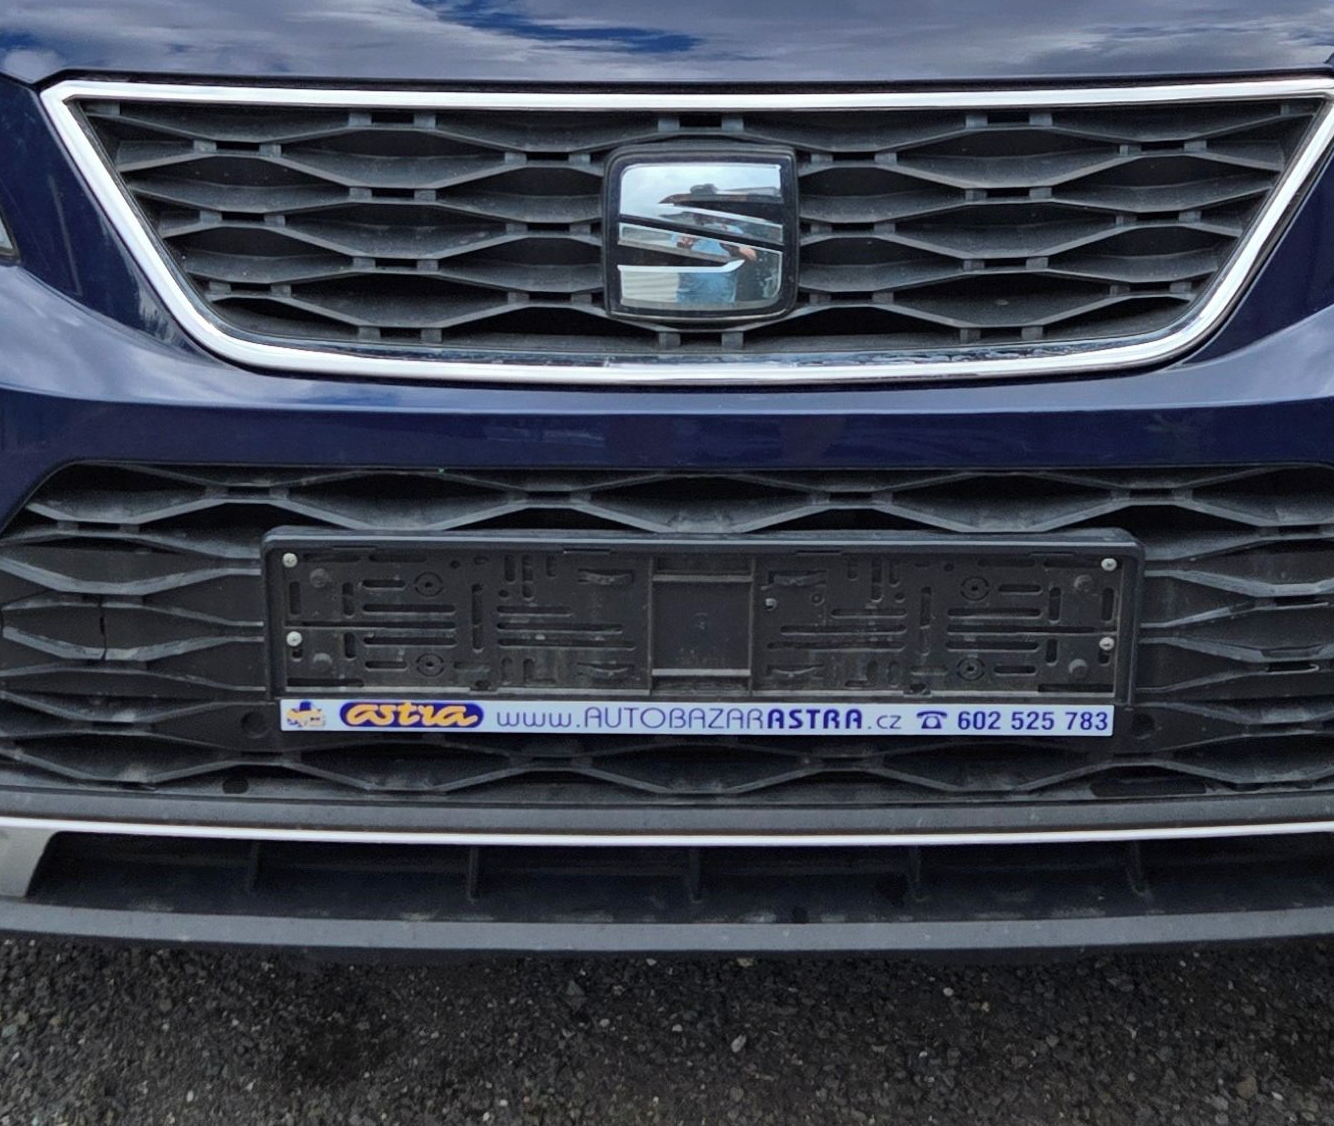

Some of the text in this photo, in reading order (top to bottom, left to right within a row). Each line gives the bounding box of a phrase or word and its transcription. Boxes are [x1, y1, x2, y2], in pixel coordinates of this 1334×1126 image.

[345, 701, 480, 729] astra
[957, 710, 1002, 731] 602
[1010, 711, 1055, 731] 525
[1065, 711, 1109, 732] 783
